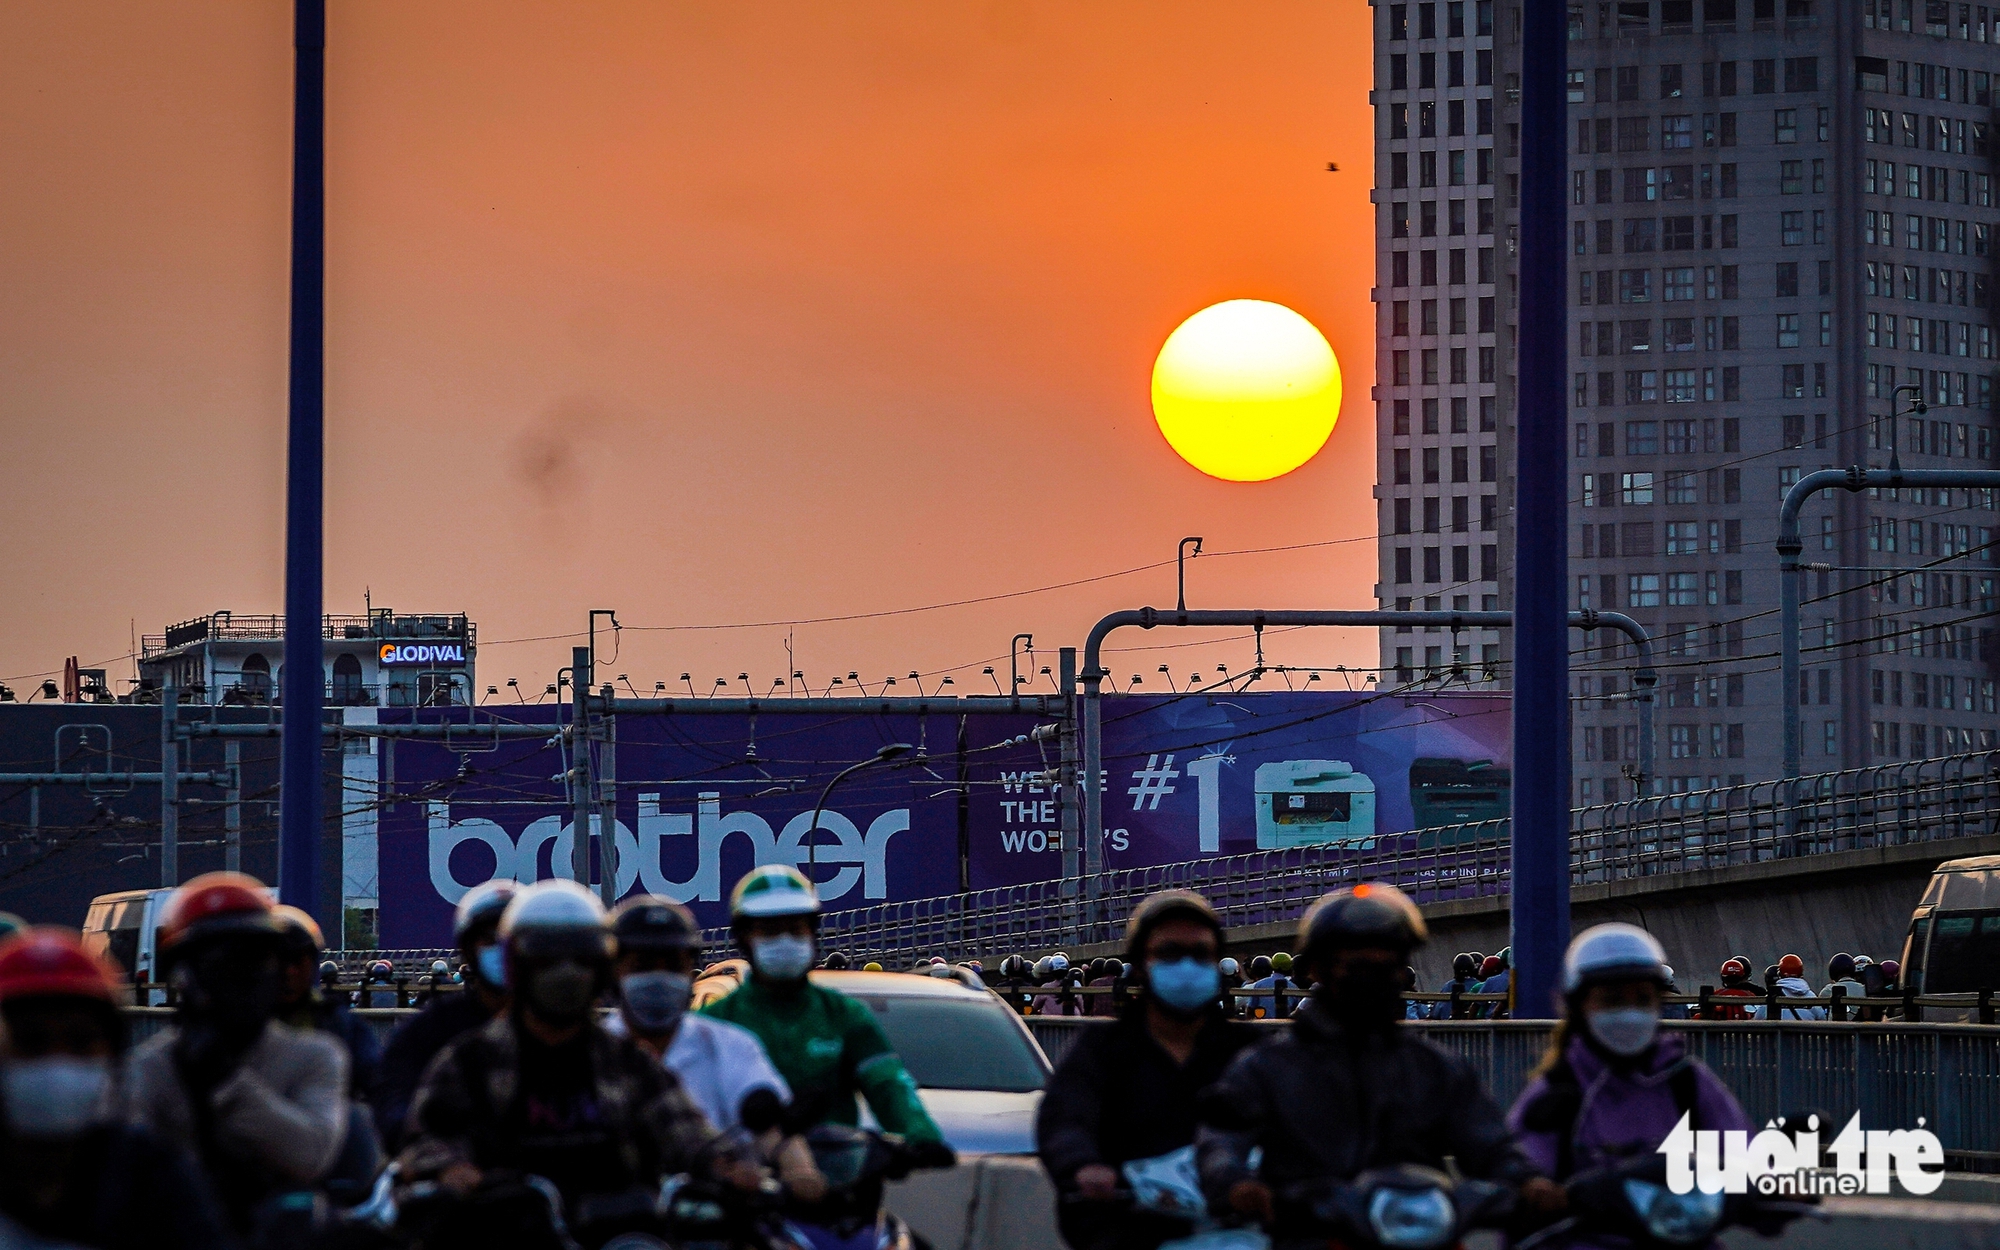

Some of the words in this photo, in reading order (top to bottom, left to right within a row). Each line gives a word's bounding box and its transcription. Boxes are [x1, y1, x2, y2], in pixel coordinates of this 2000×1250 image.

[380, 643, 465, 663] GLODIVAL
[1000, 771, 1045, 794] WE
[1000, 800, 1056, 823] THE
[428, 791, 910, 905] brother
[1000, 828, 1130, 853] WO'S
